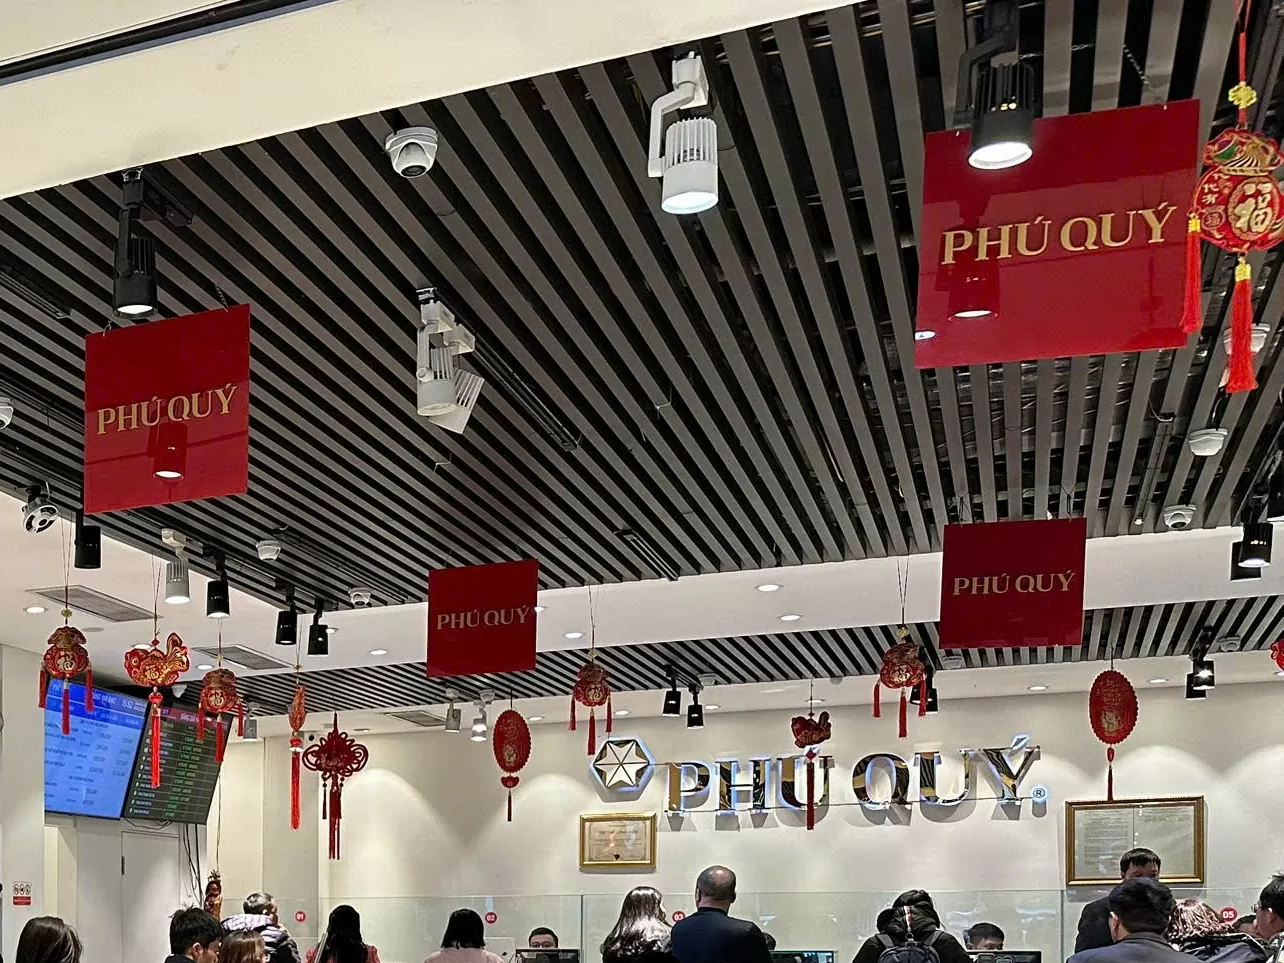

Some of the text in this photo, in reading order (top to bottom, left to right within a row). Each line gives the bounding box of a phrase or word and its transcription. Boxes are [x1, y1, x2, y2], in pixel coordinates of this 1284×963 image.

[941, 202, 1178, 265] PHÚ QUÝ
[97, 383, 238, 435] PHÚ QUÝ
[952, 570, 1076, 596] PHÚ QUÝ
[437, 605, 530, 630] PHÚ QUÝ
[664, 745, 833, 814] PHÚ
[852, 733, 1042, 810] QUÝ
[1222, 910, 1235, 919] 05
